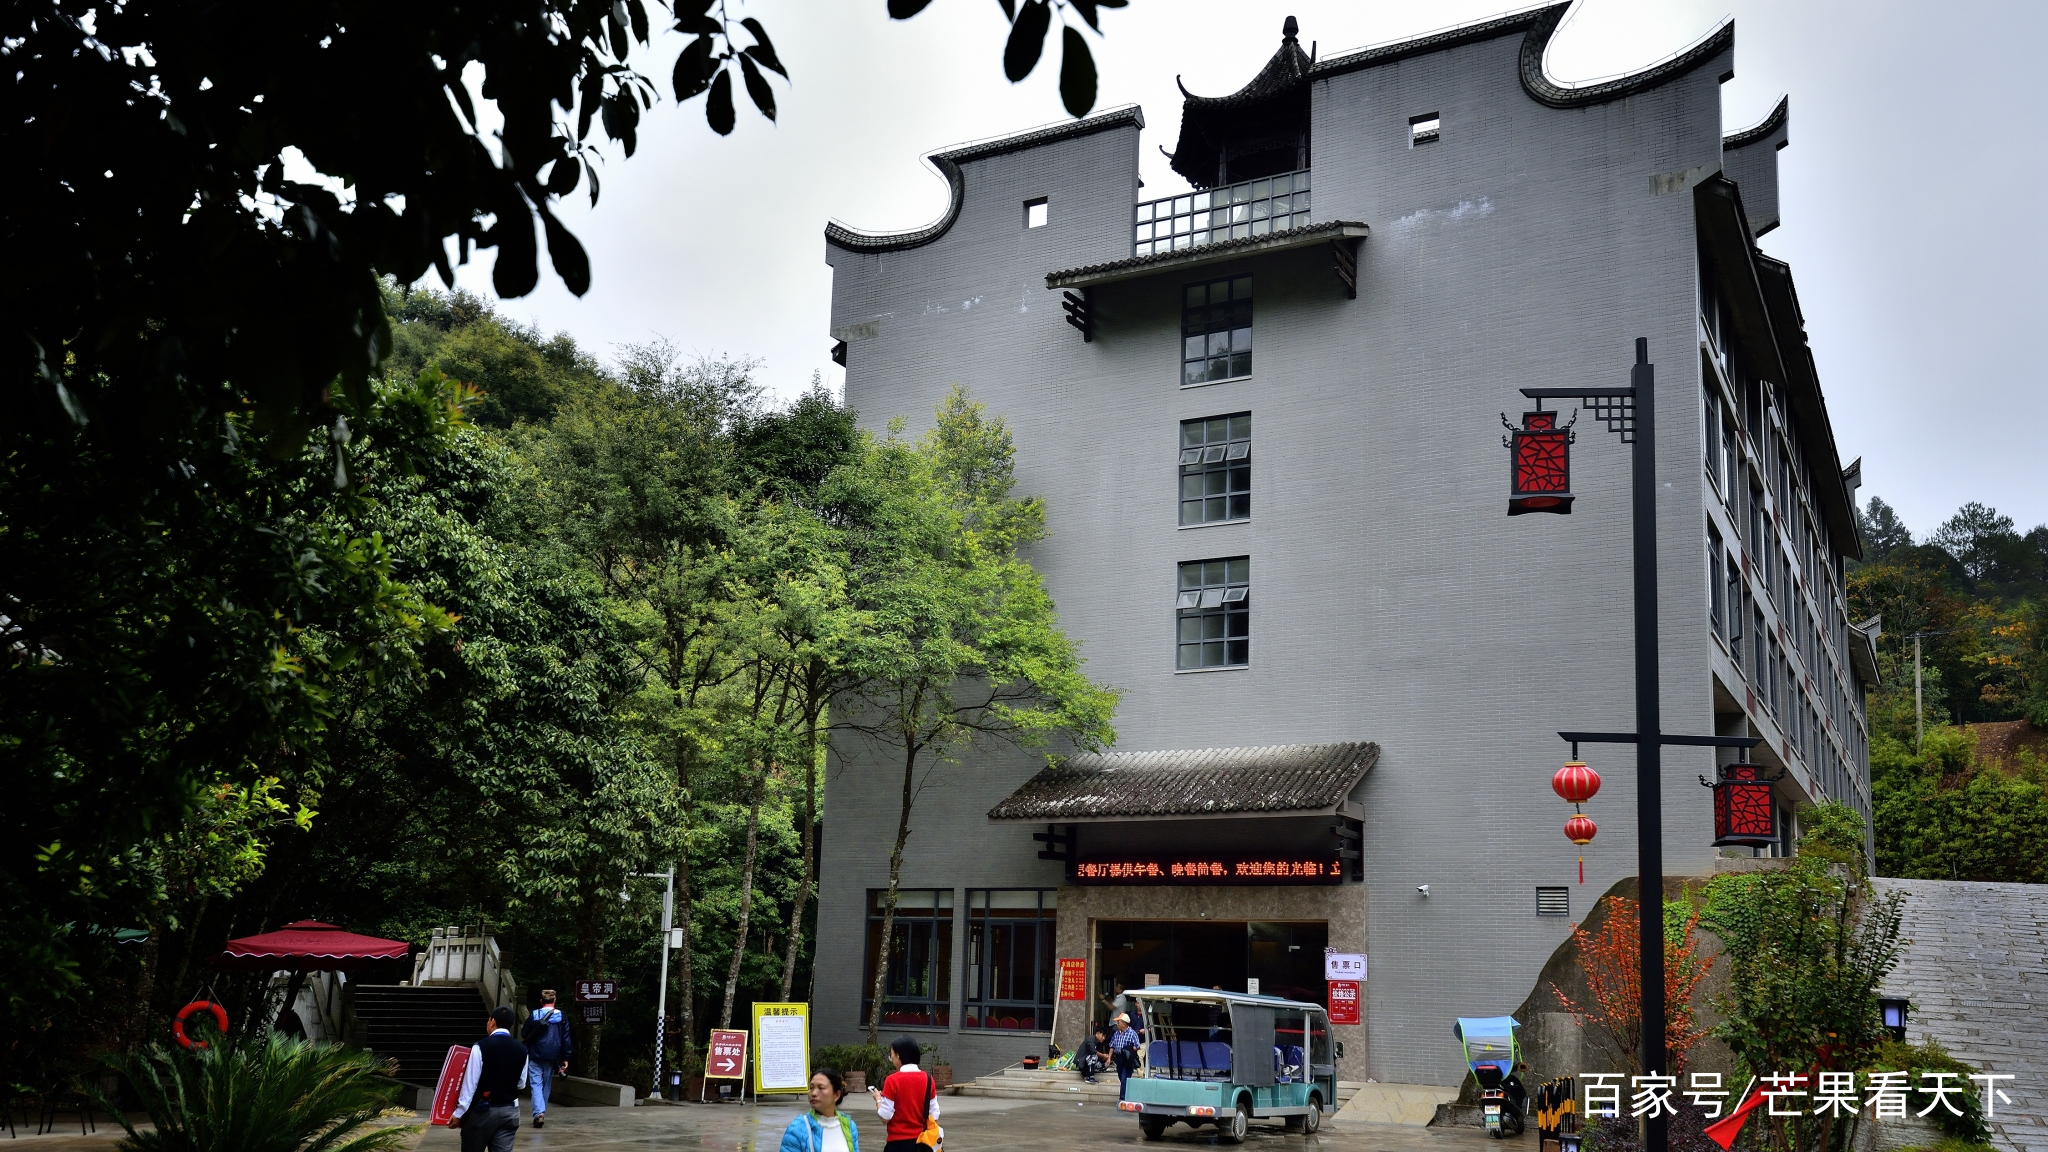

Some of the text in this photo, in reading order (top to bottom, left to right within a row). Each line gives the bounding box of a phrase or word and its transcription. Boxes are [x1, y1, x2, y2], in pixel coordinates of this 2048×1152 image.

[1331, 960, 1361, 970] 售票口
[580, 982, 613, 994] 皇帝洞
[763, 1007, 798, 1016] 温馨提示
[714, 1046, 741, 1056] 售票处
